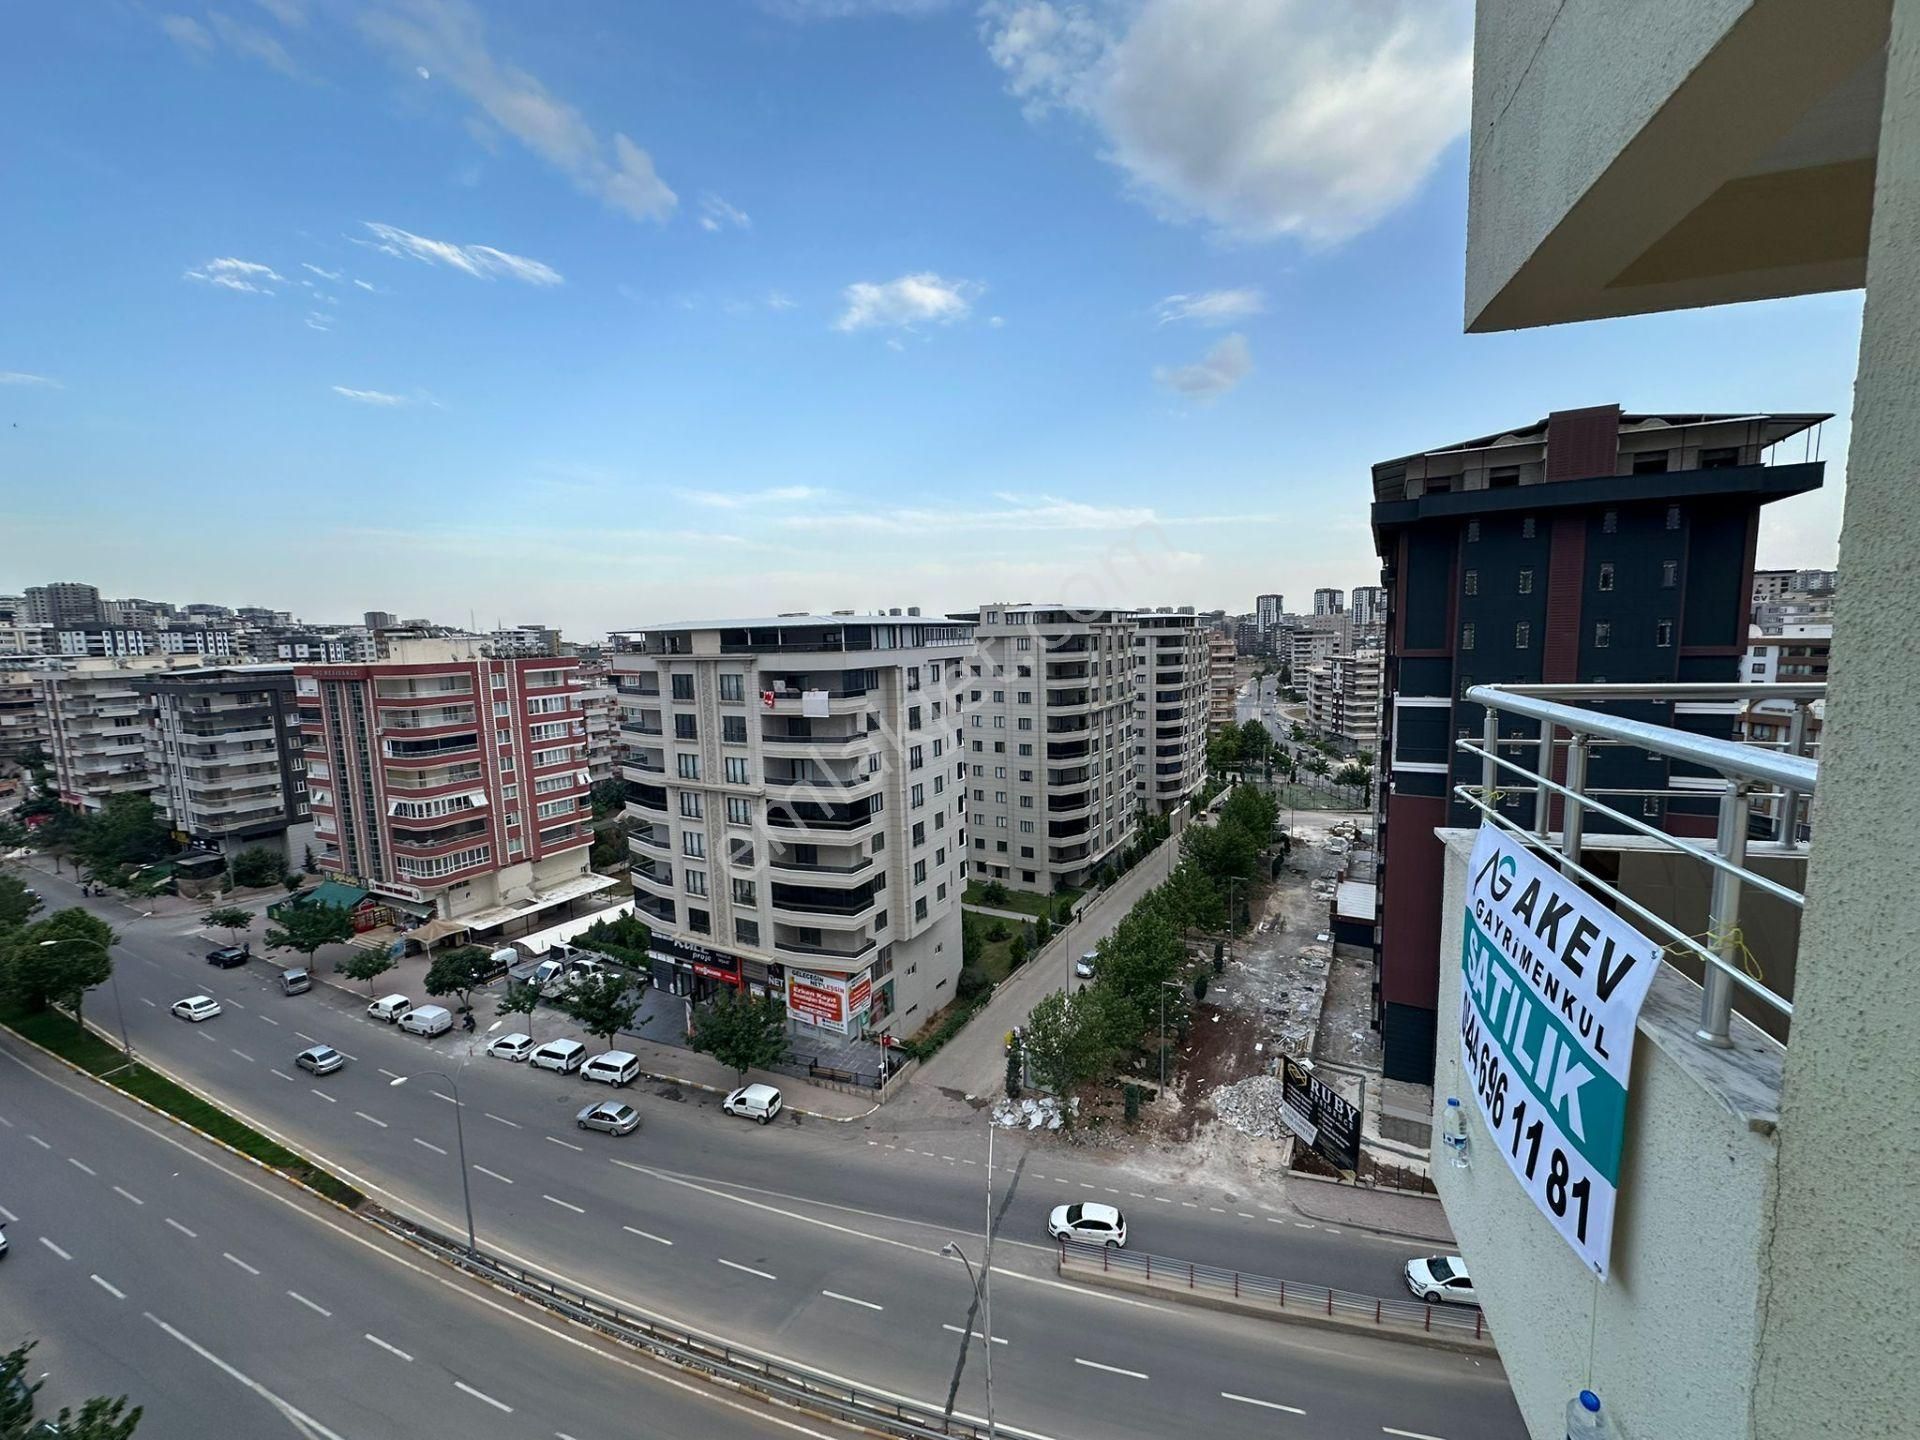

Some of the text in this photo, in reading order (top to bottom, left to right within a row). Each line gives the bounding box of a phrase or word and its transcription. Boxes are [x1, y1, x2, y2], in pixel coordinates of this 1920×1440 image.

[1511, 876, 1638, 1003] AKEV
[1310, 1077, 1357, 1123] RUBY
[1468, 927, 1597, 1144] SATILIK
[1478, 1043, 1508, 1129] 696
[1511, 1100, 1544, 1182] 11
[1546, 1147, 1592, 1246] 81
